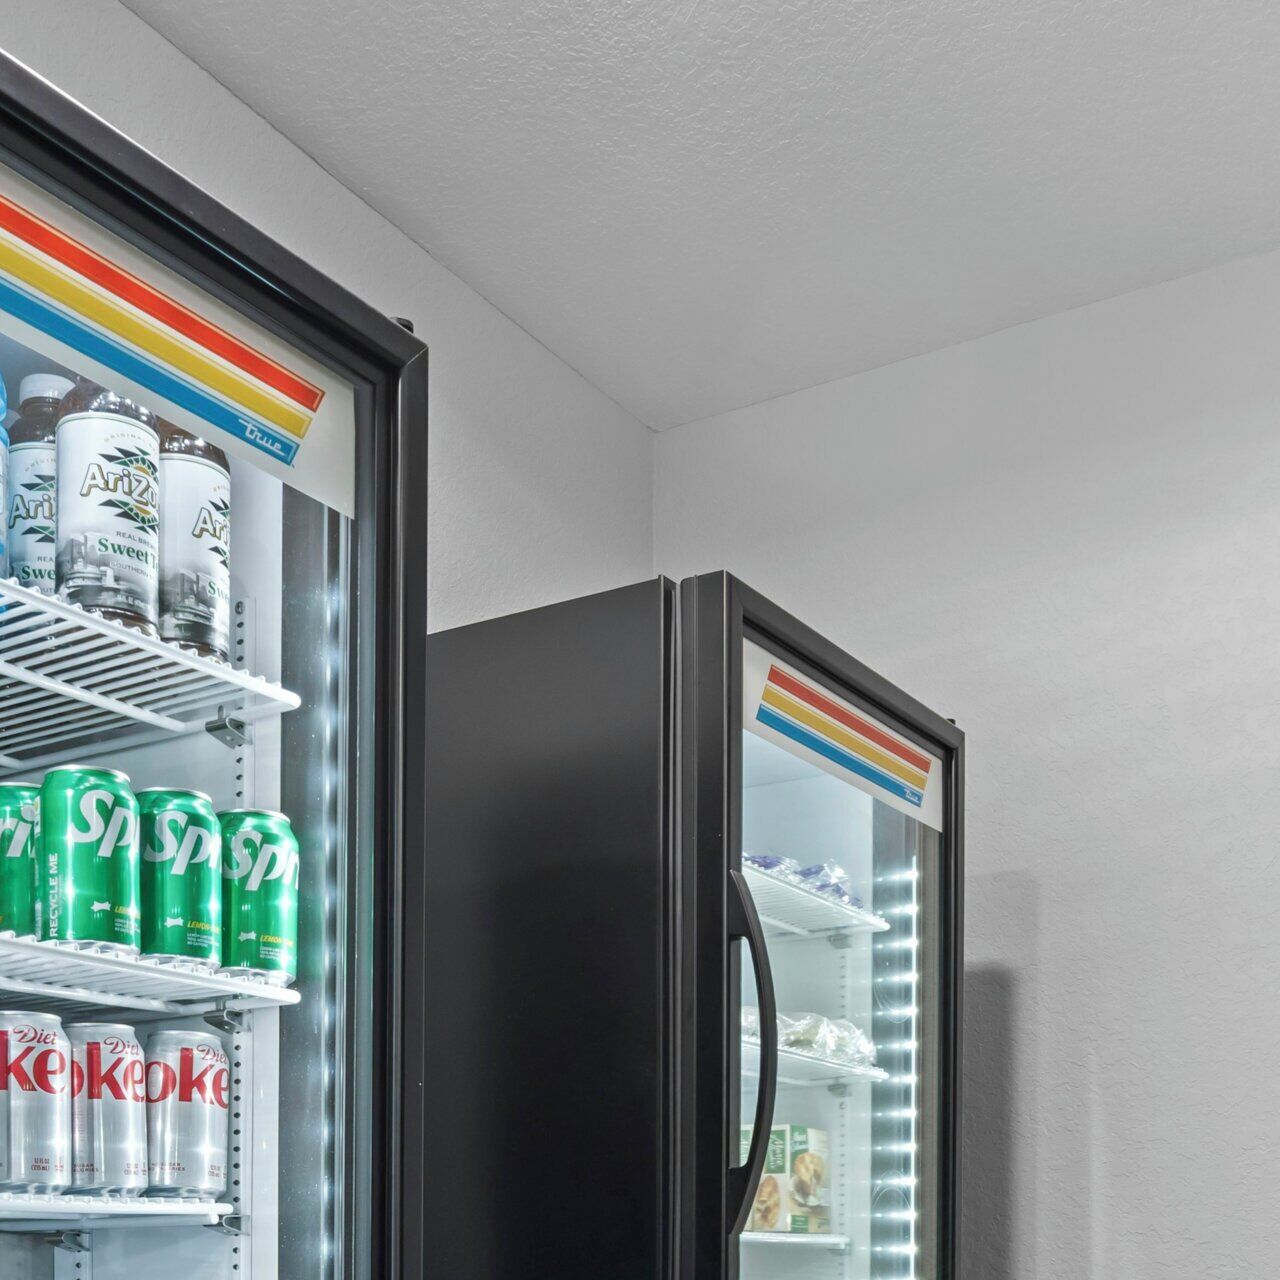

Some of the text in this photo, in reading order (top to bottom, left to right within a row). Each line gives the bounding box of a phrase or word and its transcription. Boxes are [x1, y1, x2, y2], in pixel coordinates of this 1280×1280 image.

[9, 493, 55, 529] Ari
[98, 538, 149, 565] Sweet
[49, 853, 59, 938] RECYCLE ME
[13, 1025, 58, 1045] Diet
